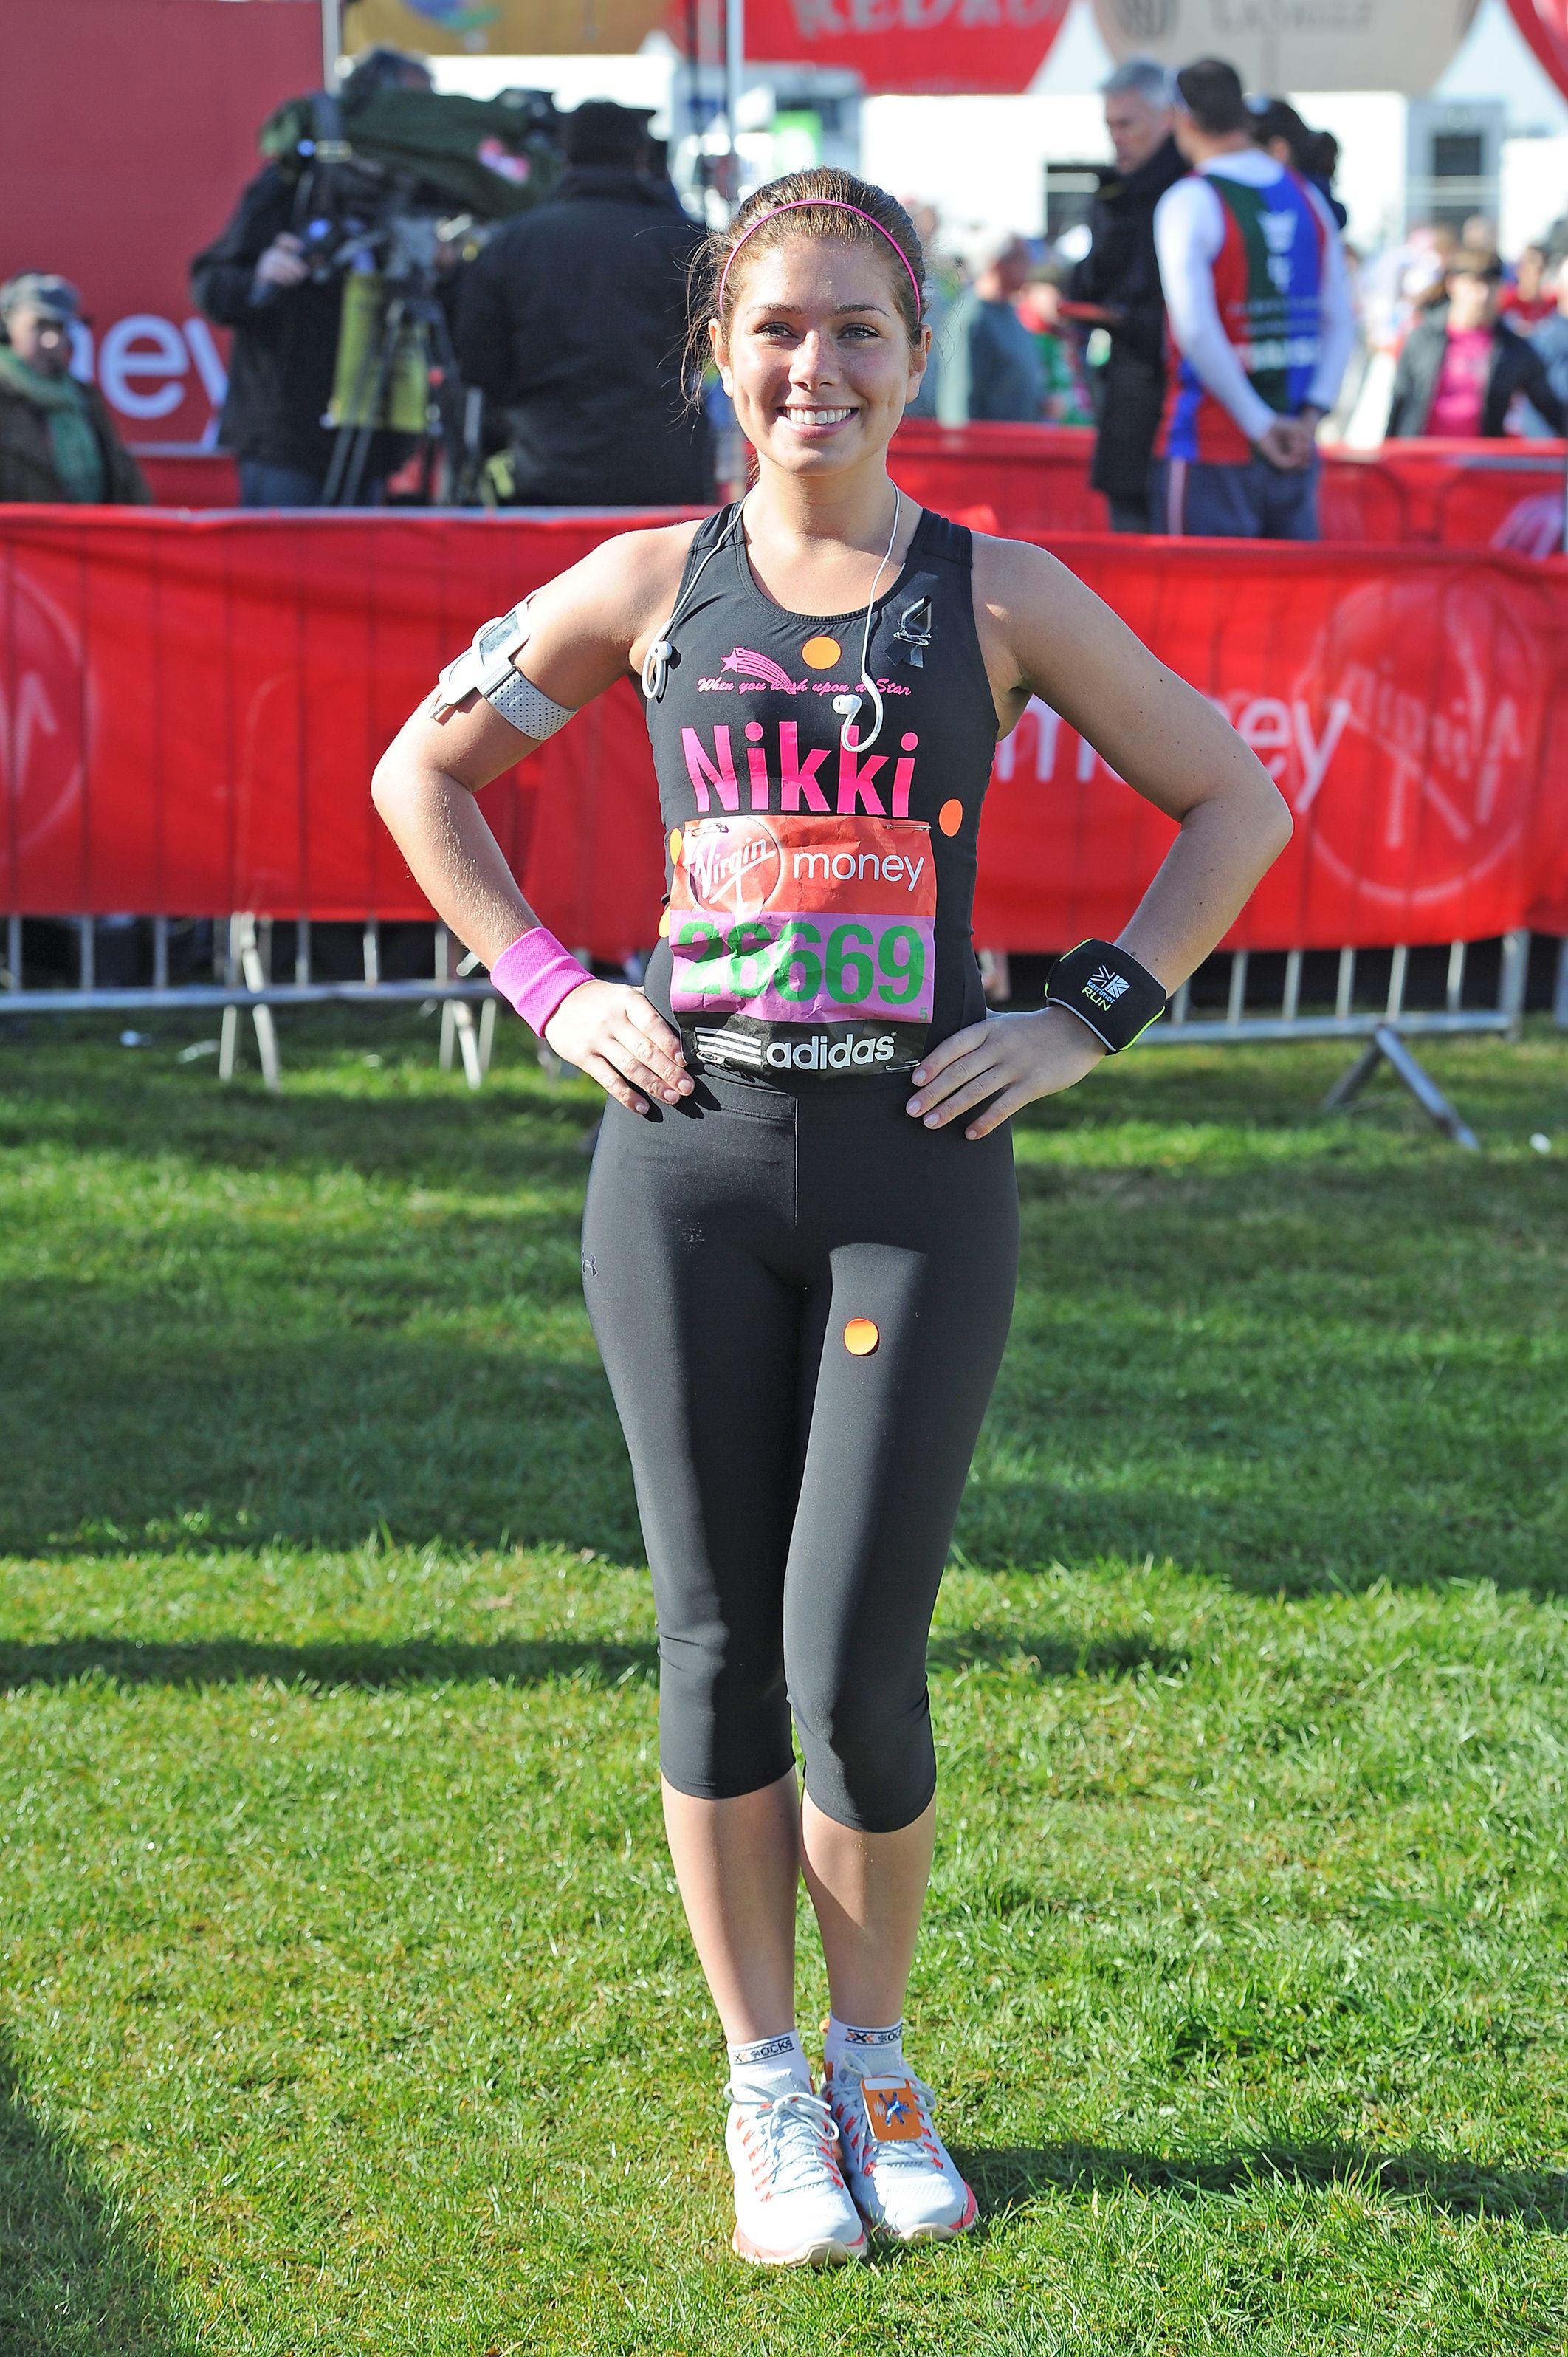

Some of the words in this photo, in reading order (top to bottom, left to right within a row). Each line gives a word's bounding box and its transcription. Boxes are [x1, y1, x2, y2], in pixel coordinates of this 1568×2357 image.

[698, 676, 735, 693] When
[738, 682, 766, 695] you
[812, 681, 850, 696] upon
[854, 683, 866, 693] a
[876, 678, 912, 696] Star
[681, 721, 918, 818] Nikki
[691, 837, 777, 922] Virgin
[792, 851, 924, 892] money
[677, 921, 926, 1005] 26669
[1081, 986, 1112, 1012] RUN
[1086, 979, 1116, 1004] karrimor
[918, 1006, 929, 1021] 5
[765, 1034, 896, 1071] adidas
